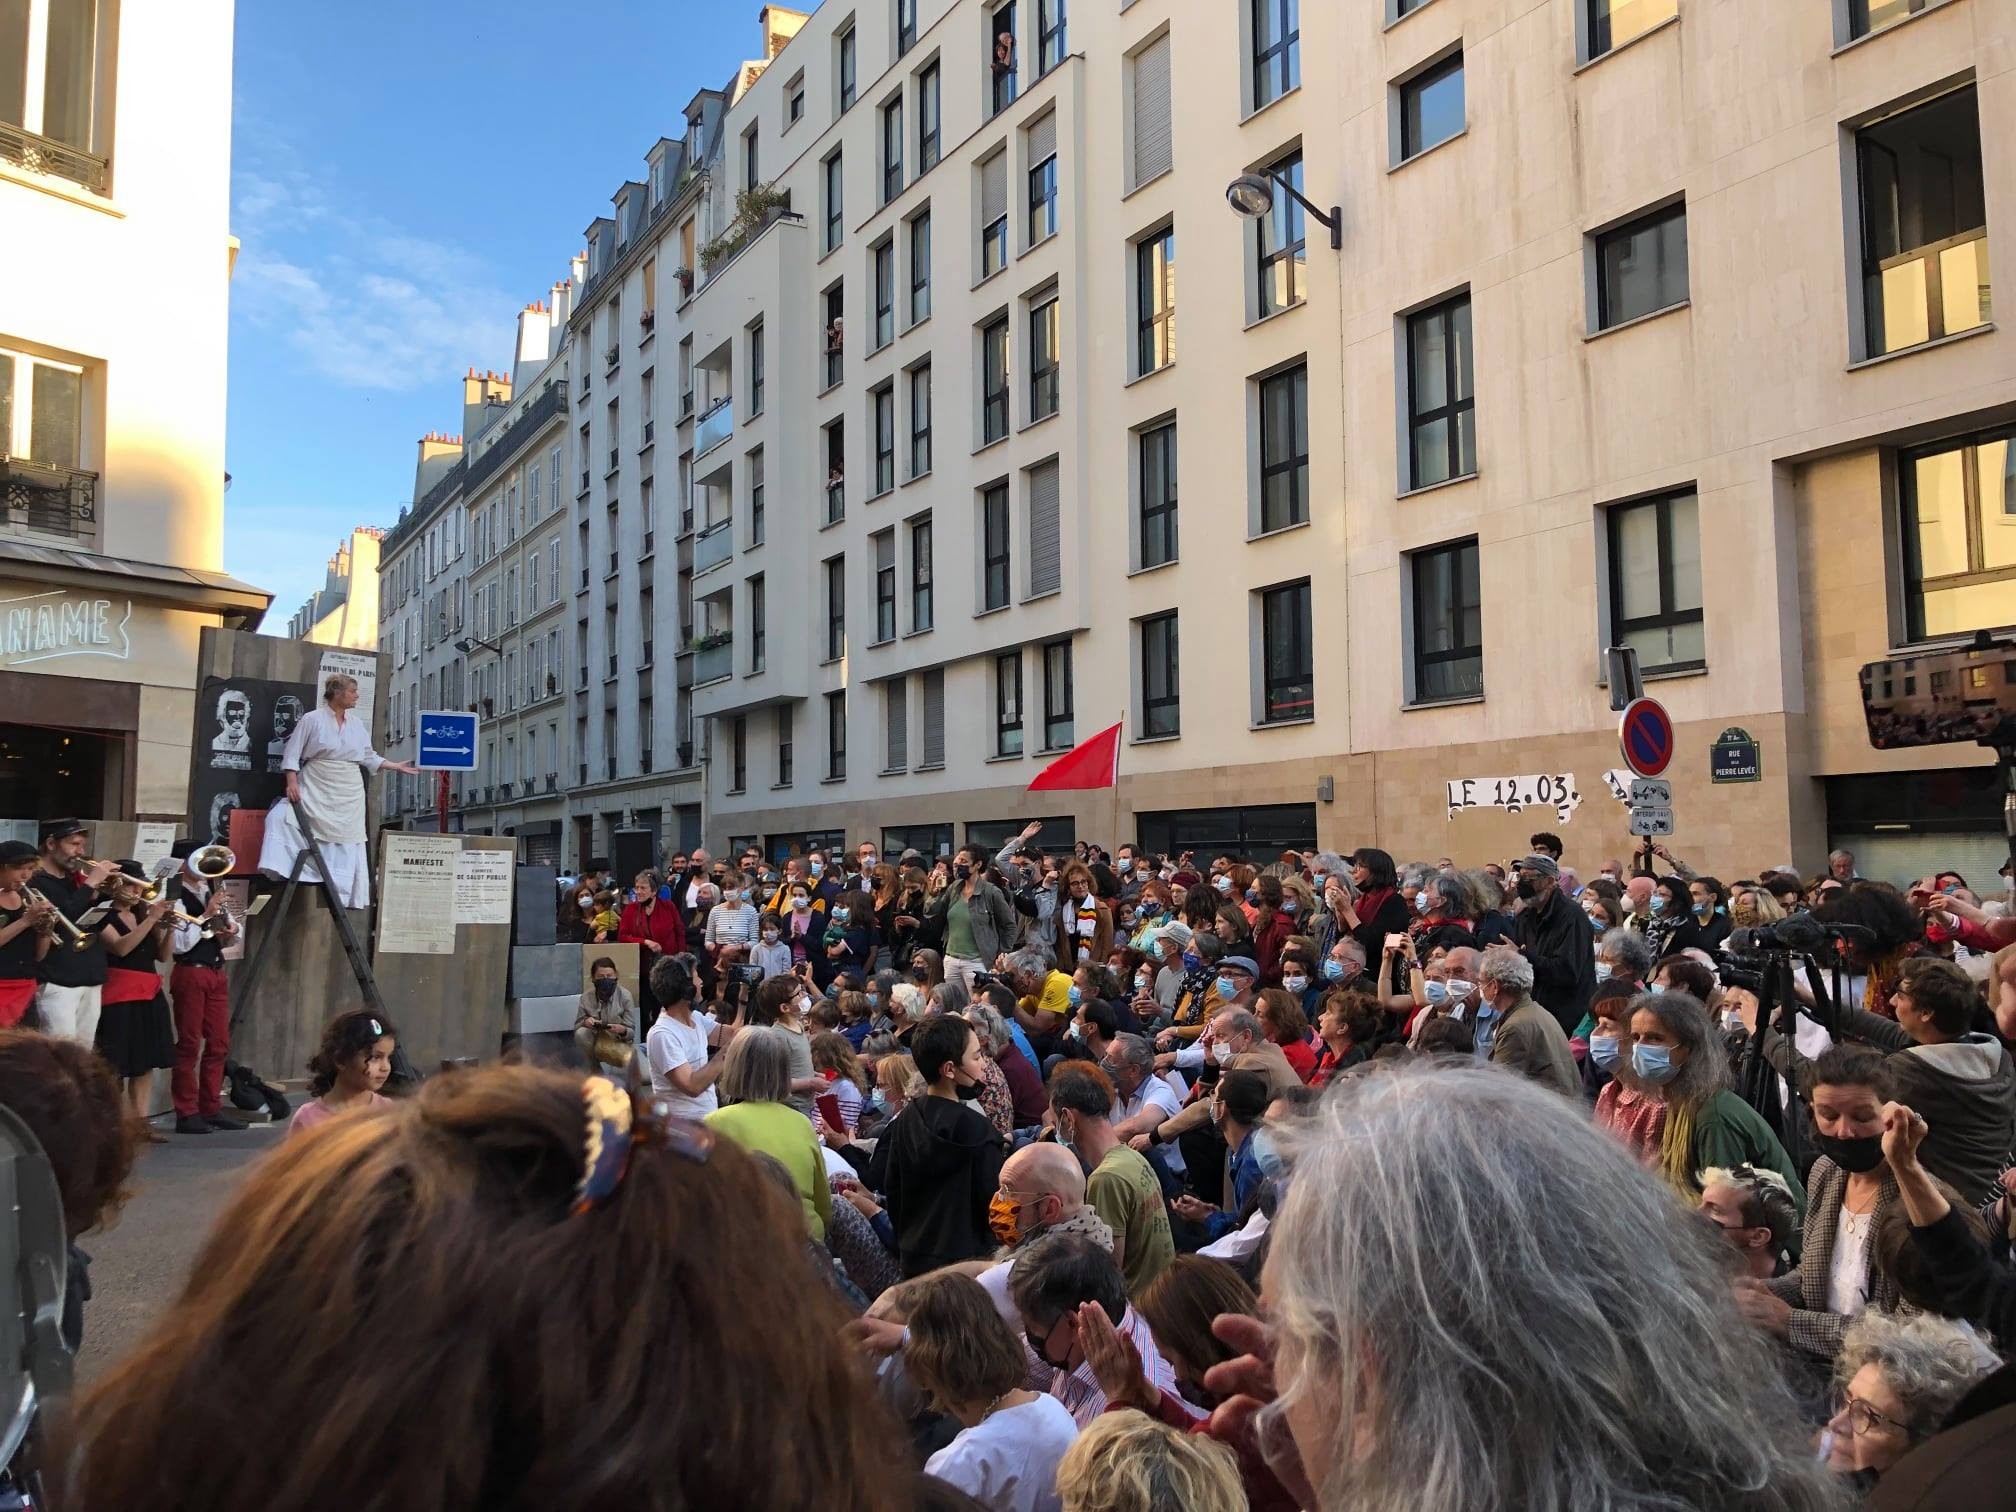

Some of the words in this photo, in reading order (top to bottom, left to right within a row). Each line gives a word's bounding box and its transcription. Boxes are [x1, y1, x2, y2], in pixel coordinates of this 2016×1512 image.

[0, 600, 112, 656] NAME
[1728, 750, 1741, 758] RUE
[1715, 768, 1737, 776] PIERRE
[1737, 765, 1756, 775] LEVÉE
[1448, 780, 1477, 808] LE
[403, 857, 445, 867] MANIFESTE
